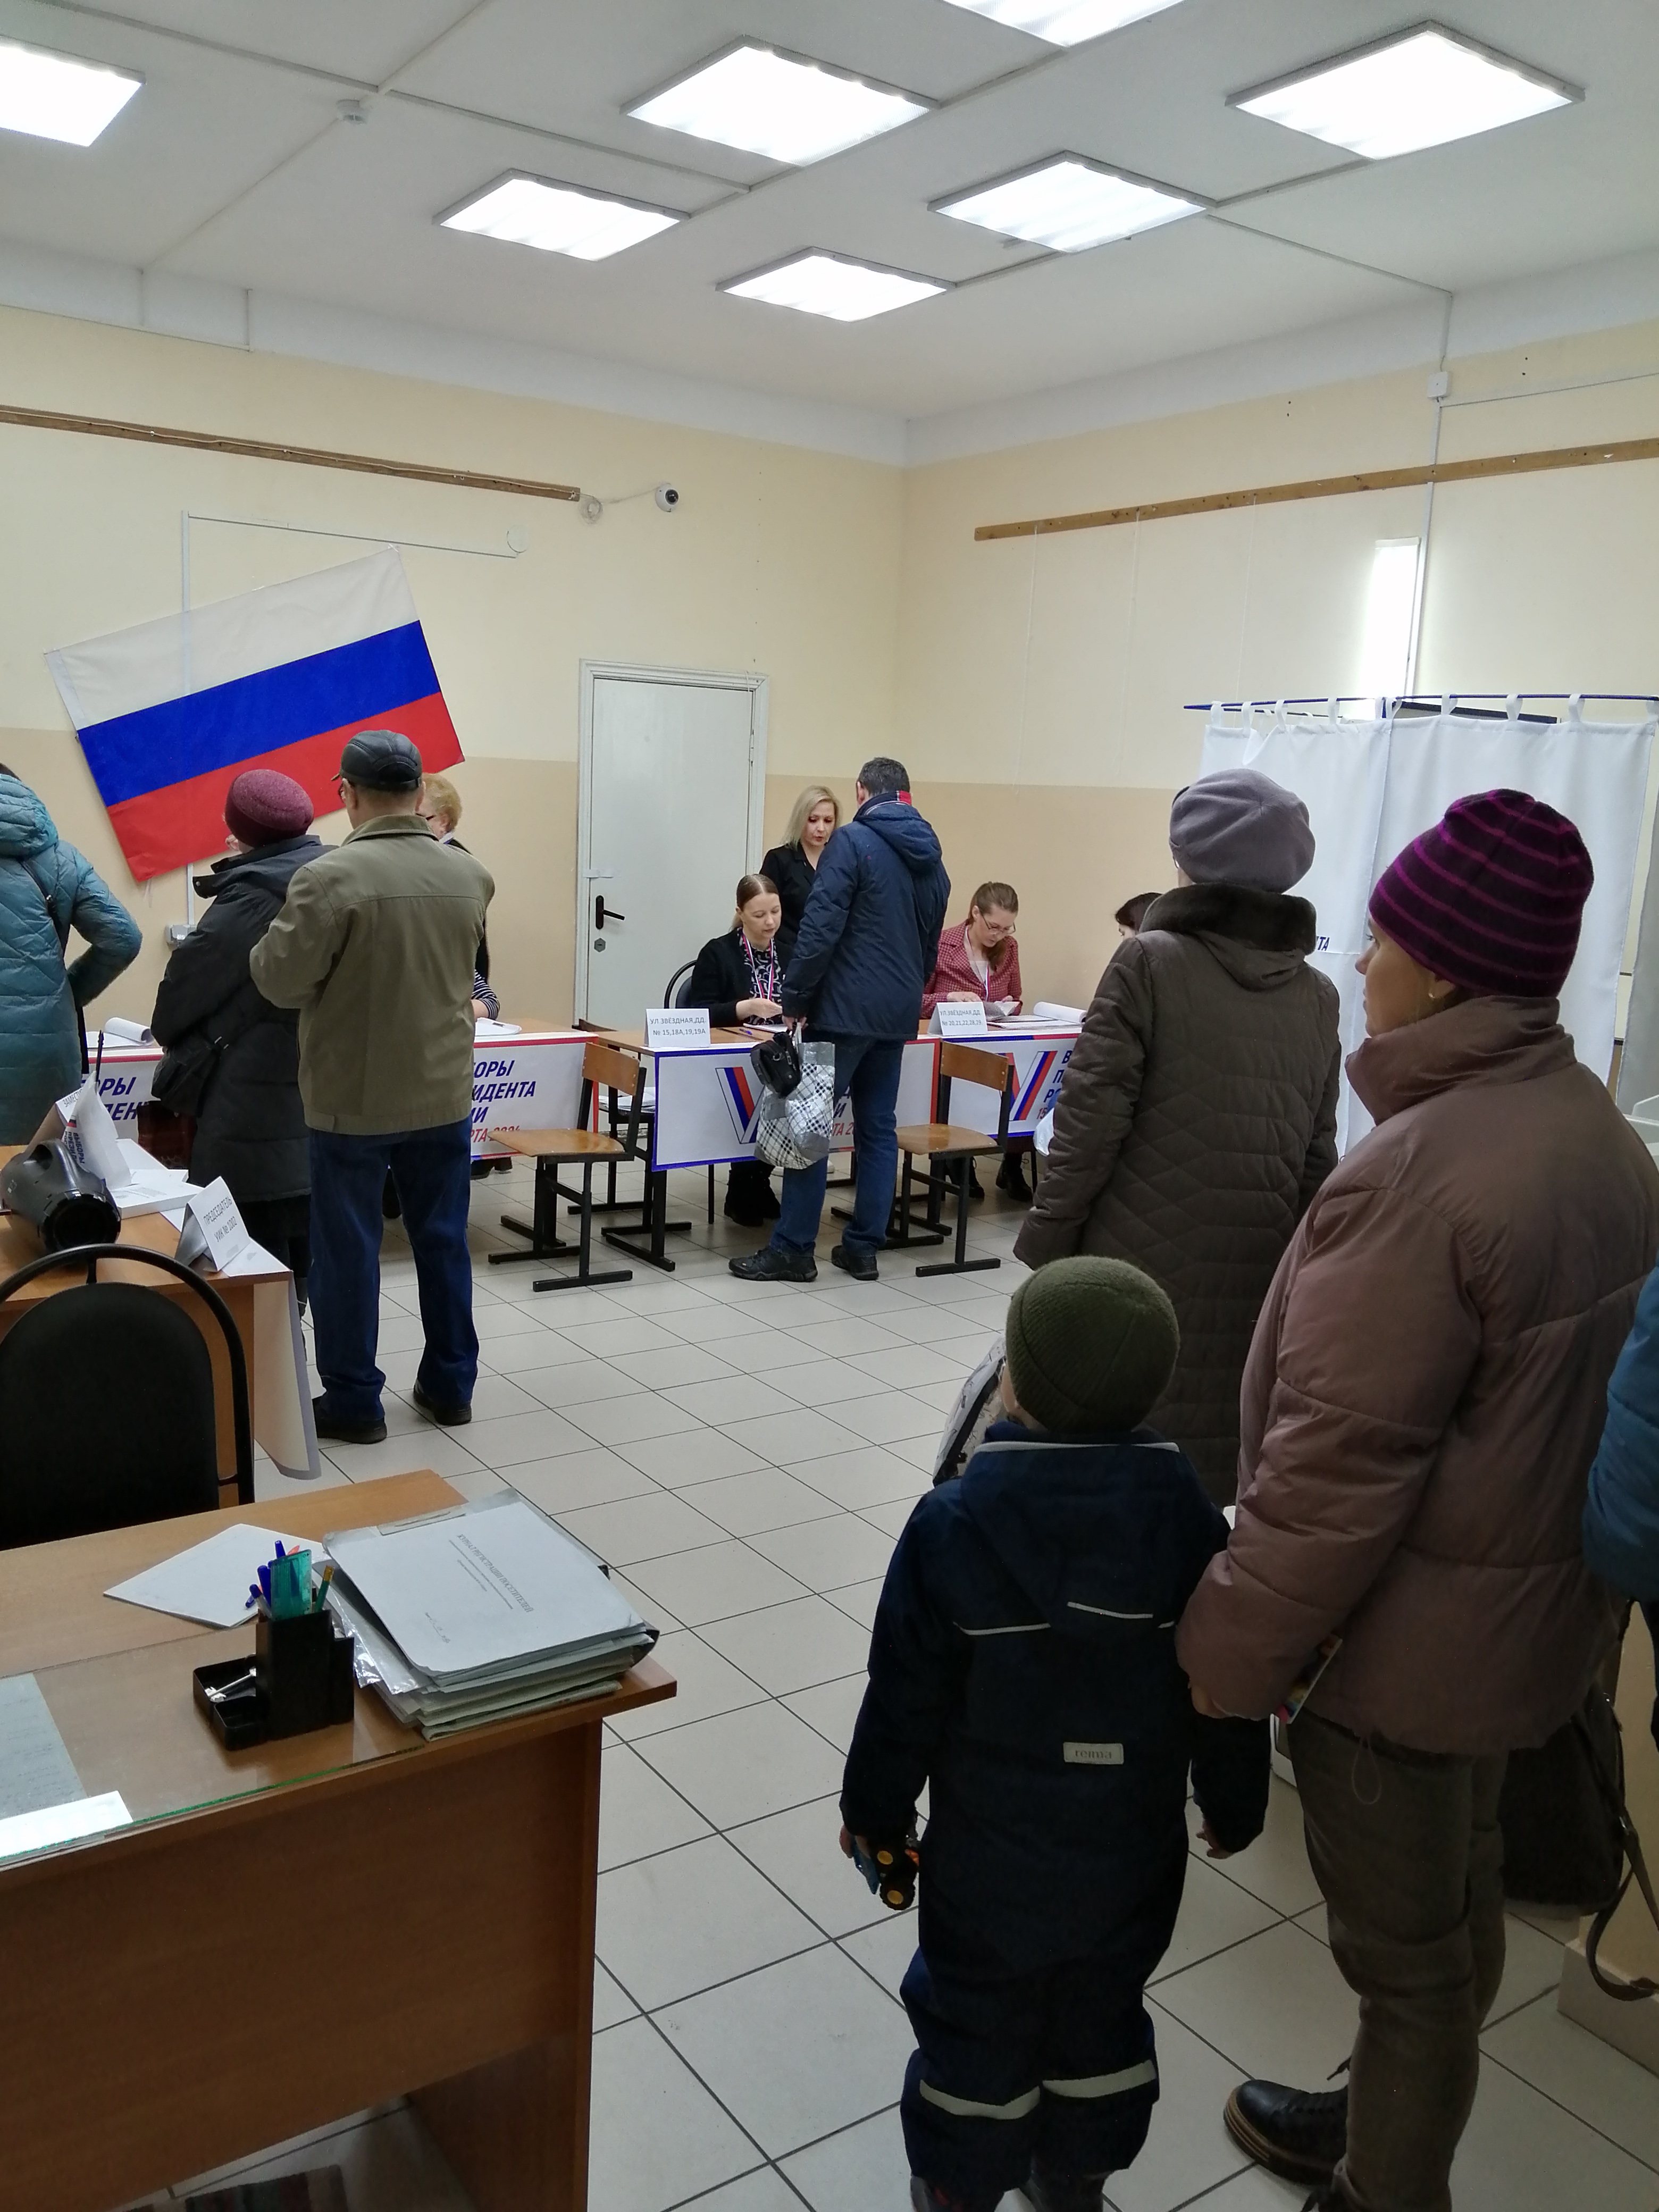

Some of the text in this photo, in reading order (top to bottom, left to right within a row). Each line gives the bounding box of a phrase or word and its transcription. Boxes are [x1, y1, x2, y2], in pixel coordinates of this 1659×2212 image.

[474, 1060, 515, 1079] ОРЫ
[73, 1133, 85, 1164] ВЫБОРЫ
[203, 1196, 232, 1226] ПРЕДСЕДАТЕЛЬ
[214, 1229, 224, 1243] УИК
